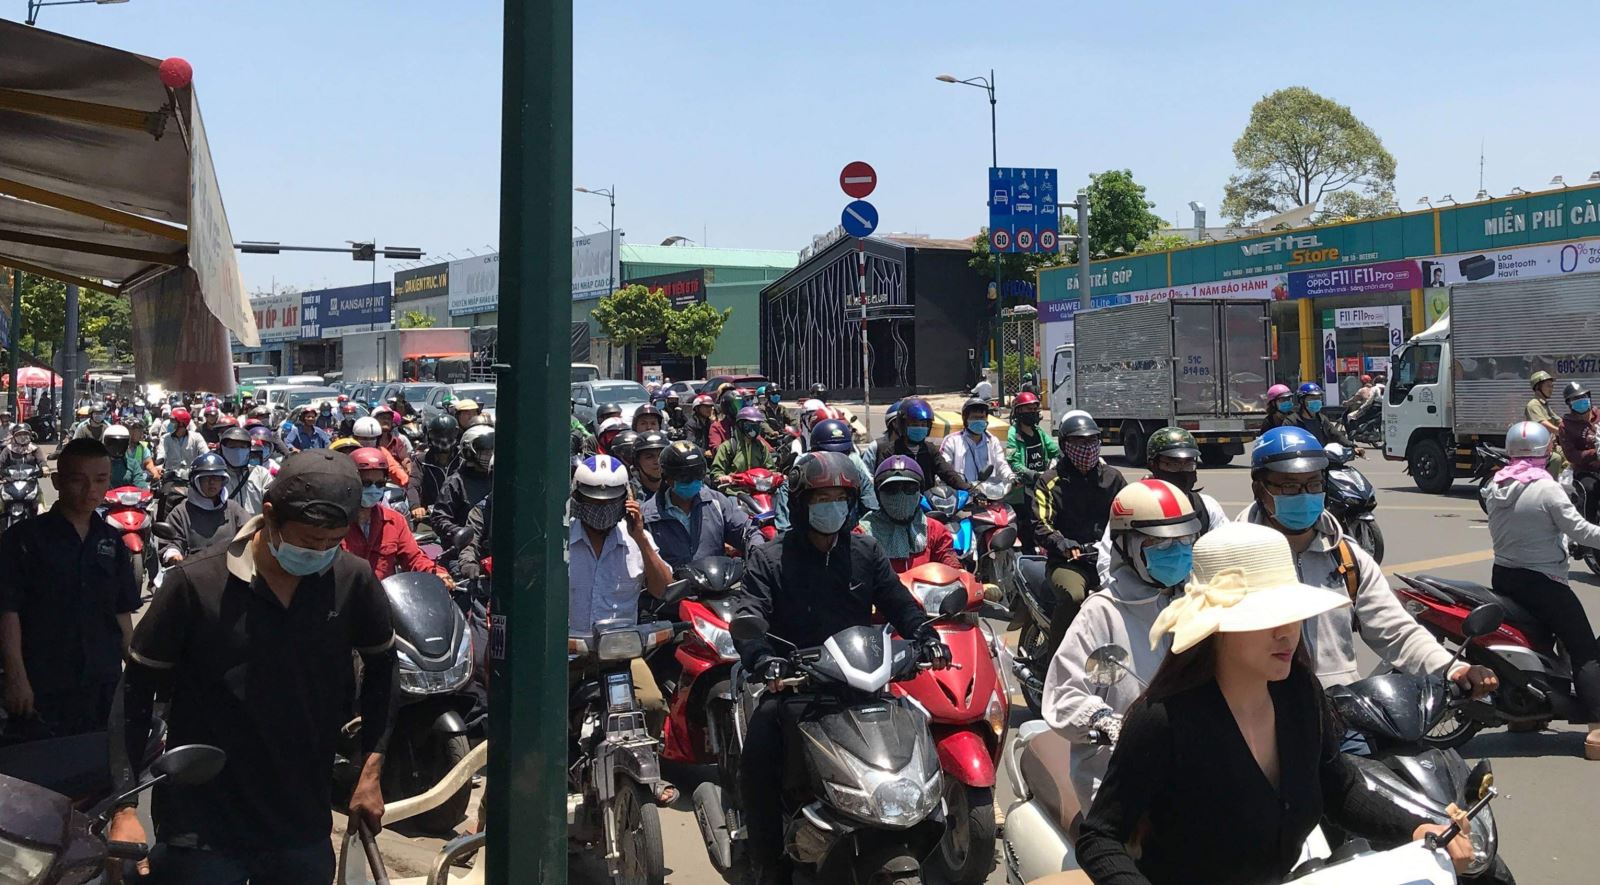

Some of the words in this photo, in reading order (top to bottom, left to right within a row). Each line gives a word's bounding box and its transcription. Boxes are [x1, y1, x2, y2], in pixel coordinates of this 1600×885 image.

[1484, 206, 1526, 236] MIỄN
[1532, 203, 1563, 230] PHÍ
[1570, 199, 1600, 225] CÀ
[996, 234, 1007, 245] 60
[1021, 234, 1029, 245] 60
[1044, 234, 1052, 245] 60
[1291, 247, 1339, 265] Store
[1497, 253, 1513, 261] Loa
[1498, 259, 1537, 270] Bluetooth
[1089, 268, 1107, 287] TRẢ
[1112, 266, 1133, 284] GÓP
[1307, 278, 1331, 288] OPPO
[1331, 270, 1349, 285] F11
[1355, 268, 1373, 283] F11
[1375, 271, 1394, 281] Pro
[1498, 269, 1519, 278] Havit
[1192, 286, 1197, 297] 1
[1241, 279, 1268, 291] HÀNH
[340, 299, 365, 310] KANSAI
[1049, 301, 1080, 313] HUAWEI
[1353, 310, 1364, 321] F11
[1393, 329, 1400, 342] 2
[1188, 355, 1202, 365] 51C
[1557, 359, 1600, 374] 60C-377.
